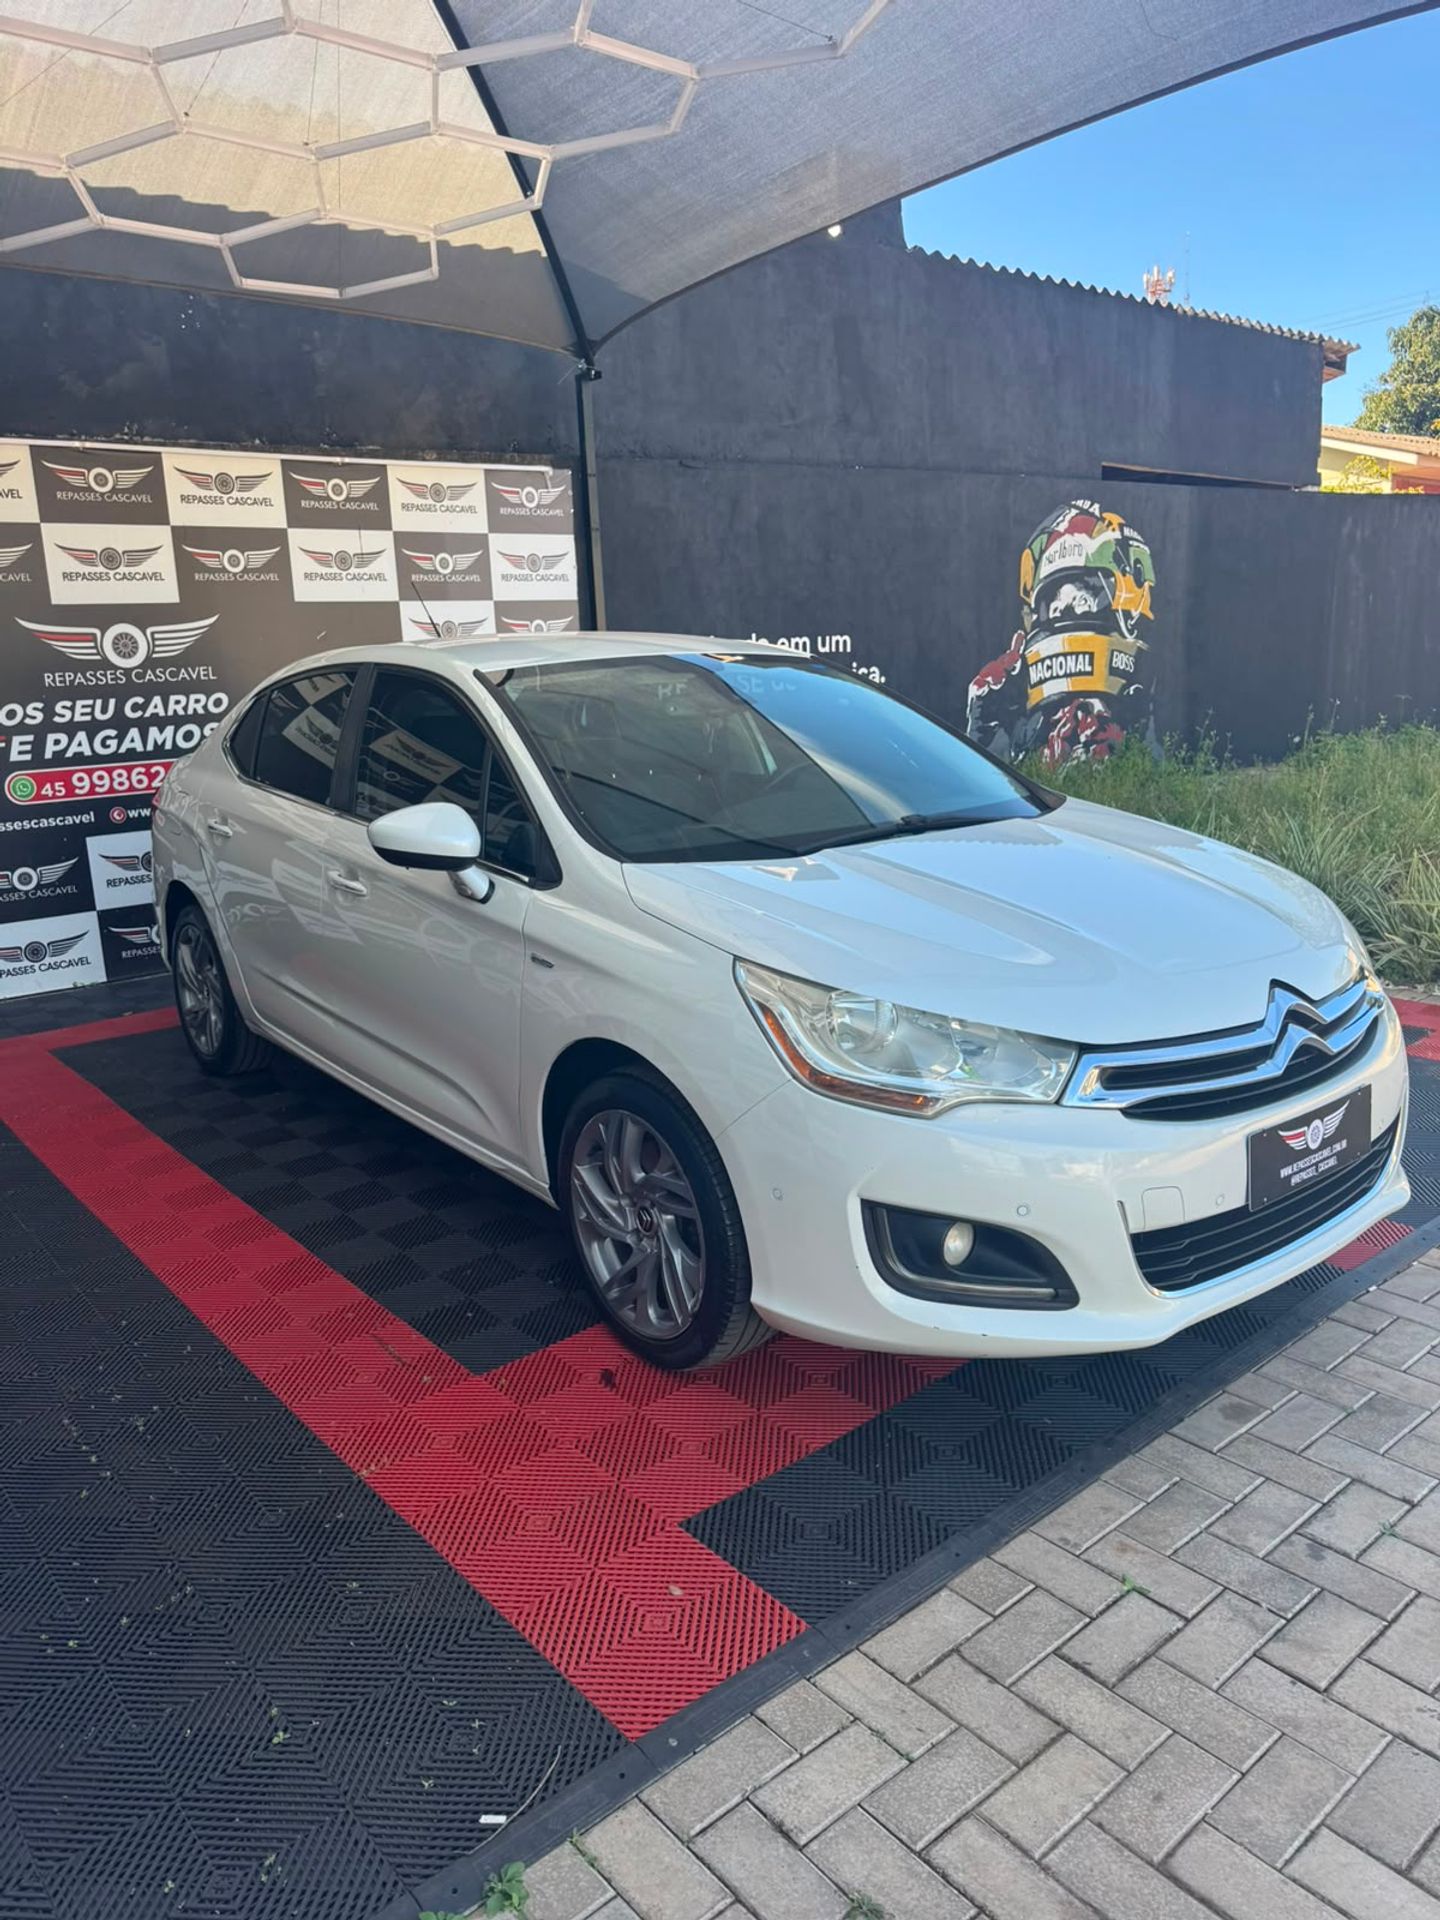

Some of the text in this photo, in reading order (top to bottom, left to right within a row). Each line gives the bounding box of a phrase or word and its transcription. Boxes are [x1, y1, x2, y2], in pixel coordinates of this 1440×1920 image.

[56, 491, 153, 504] REPASSES CASCAVEL
[180, 494, 274, 507] REPASSES CASCAVEL
[300, 499, 379, 511] REPASSES CASCAVEL
[401, 502, 478, 514] REPASSES CASCAVEL
[500, 507, 564, 517] REPASSES CASCAVEL
[62, 571, 165, 582] REPASSES CASCAVEL
[194, 572, 280, 581] REPASSES CASCAVEL
[303, 572, 388, 582] REPASSES CASCAVEL
[411, 573, 481, 582] REPASSES CASCAVEL
[501, 573, 570, 582] REPASSES CASCAVEL
[817, 634, 851, 653] um
[1111, 650, 1135, 673] BOSS
[1028, 653, 1092, 685] NACIONAL
[44, 665, 218, 687] REPASSES CASCAVEL
[53, 698, 116, 723] SEU
[124, 692, 229, 720] CARRO
[41, 765, 166, 798] 45 99862
[106, 874, 152, 888] REPASSES
[28, 885, 79, 899] CASCAVEL
[38, 956, 92, 972] CASCAVEL
